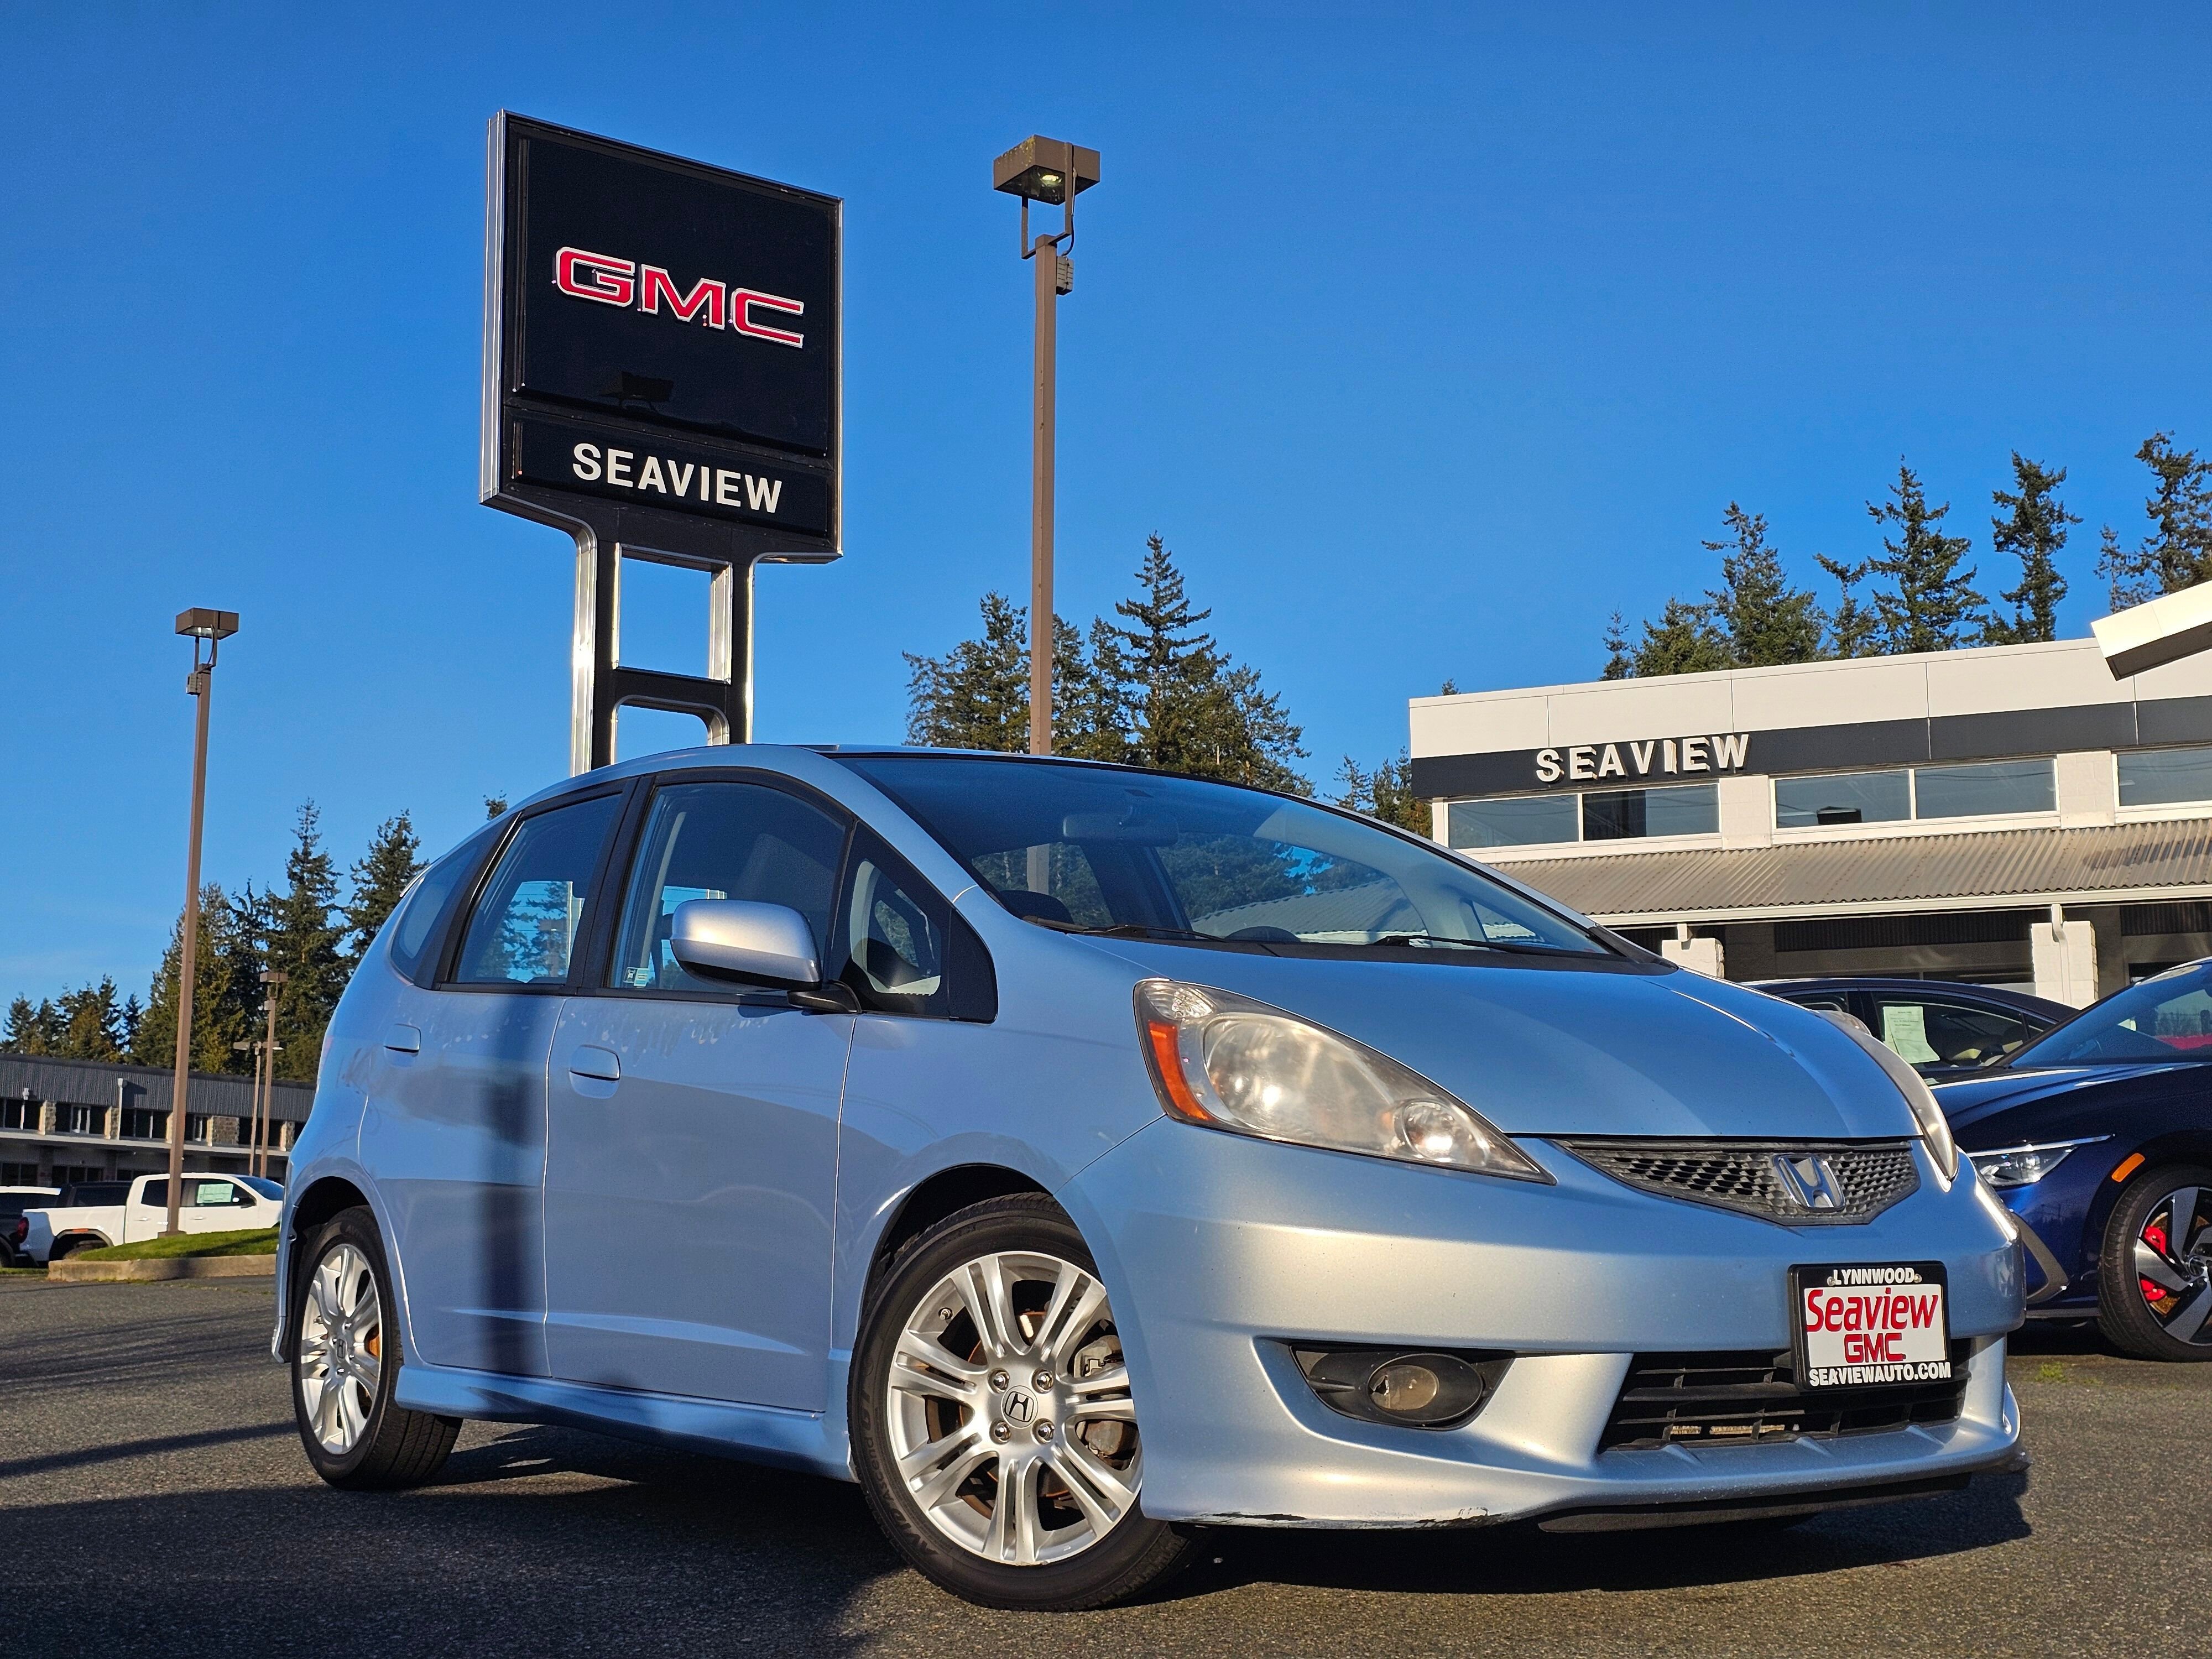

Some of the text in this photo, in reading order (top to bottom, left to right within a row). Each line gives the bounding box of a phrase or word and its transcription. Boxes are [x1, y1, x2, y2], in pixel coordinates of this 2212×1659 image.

[556, 247, 805, 348] GMC
[573, 443, 782, 513] SEAVIEW
[1536, 734, 1749, 782] SEAVIEW
[1833, 1267, 1914, 1285] LYNNWOOD
[1807, 1287, 1939, 1332] Seaview
[1809, 1362, 1952, 1387] SEAVIEWAUTO.COM
